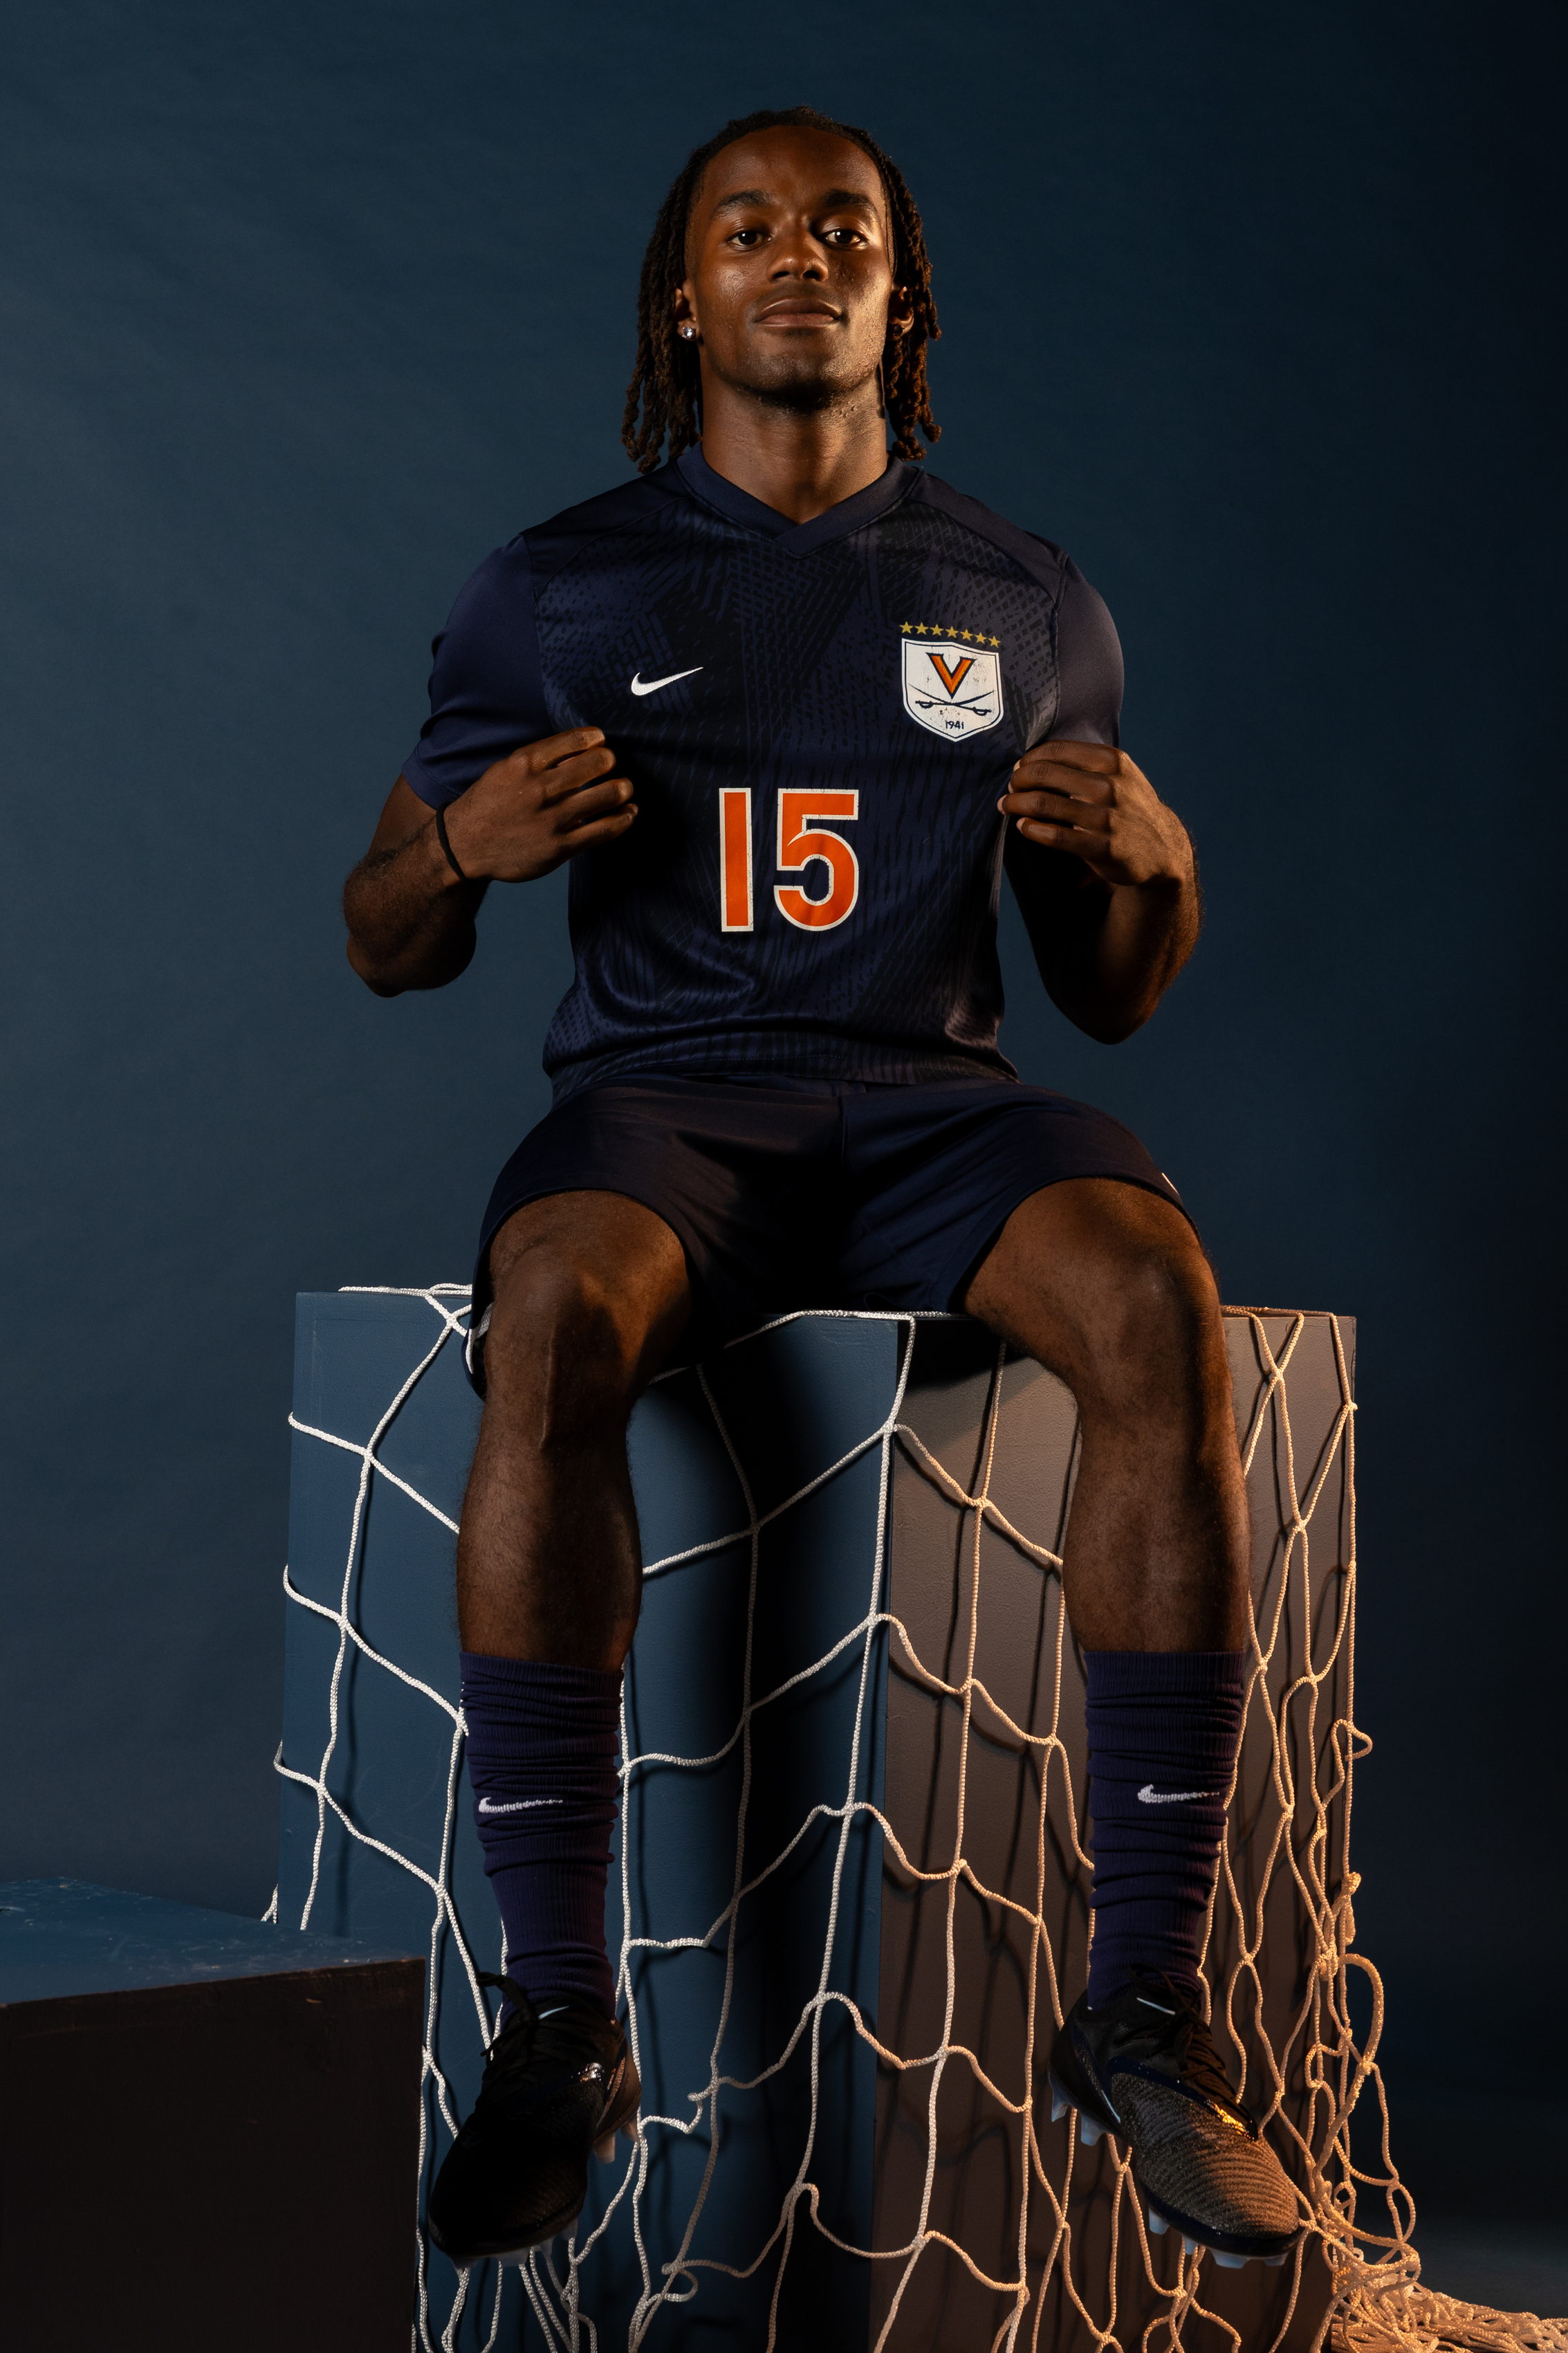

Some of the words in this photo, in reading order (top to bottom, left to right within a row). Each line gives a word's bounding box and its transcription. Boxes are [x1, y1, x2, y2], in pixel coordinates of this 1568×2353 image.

[925, 652, 977, 699] V
[945, 720, 964, 730] 1941
[719, 787, 860, 932] 15
